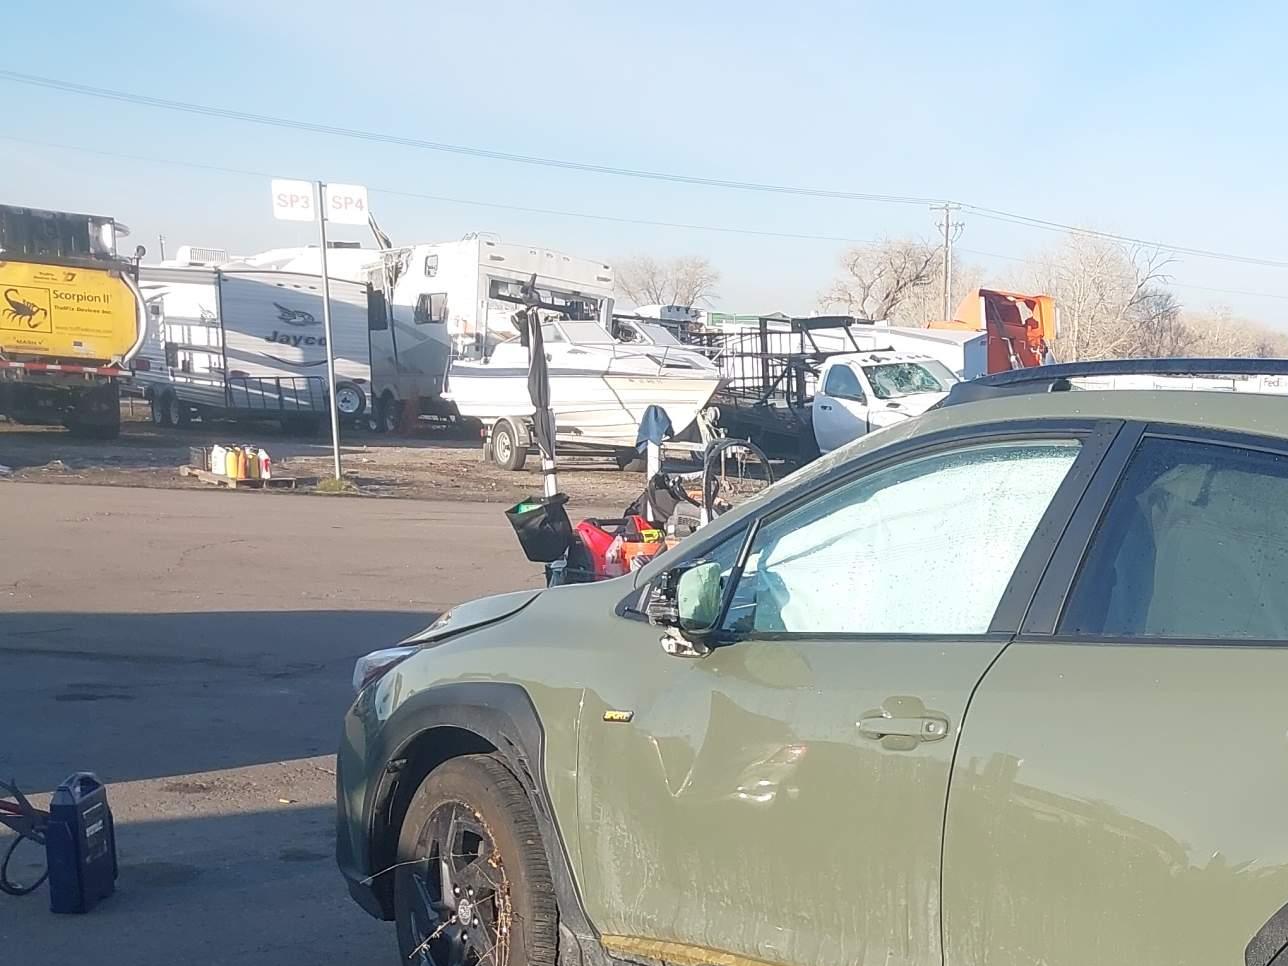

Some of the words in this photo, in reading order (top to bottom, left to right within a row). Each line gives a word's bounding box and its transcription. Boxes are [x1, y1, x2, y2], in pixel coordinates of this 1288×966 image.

[277, 193, 310, 209] SP3
[331, 195, 365, 211] SP4
[53, 289, 101, 303] Scorpion
